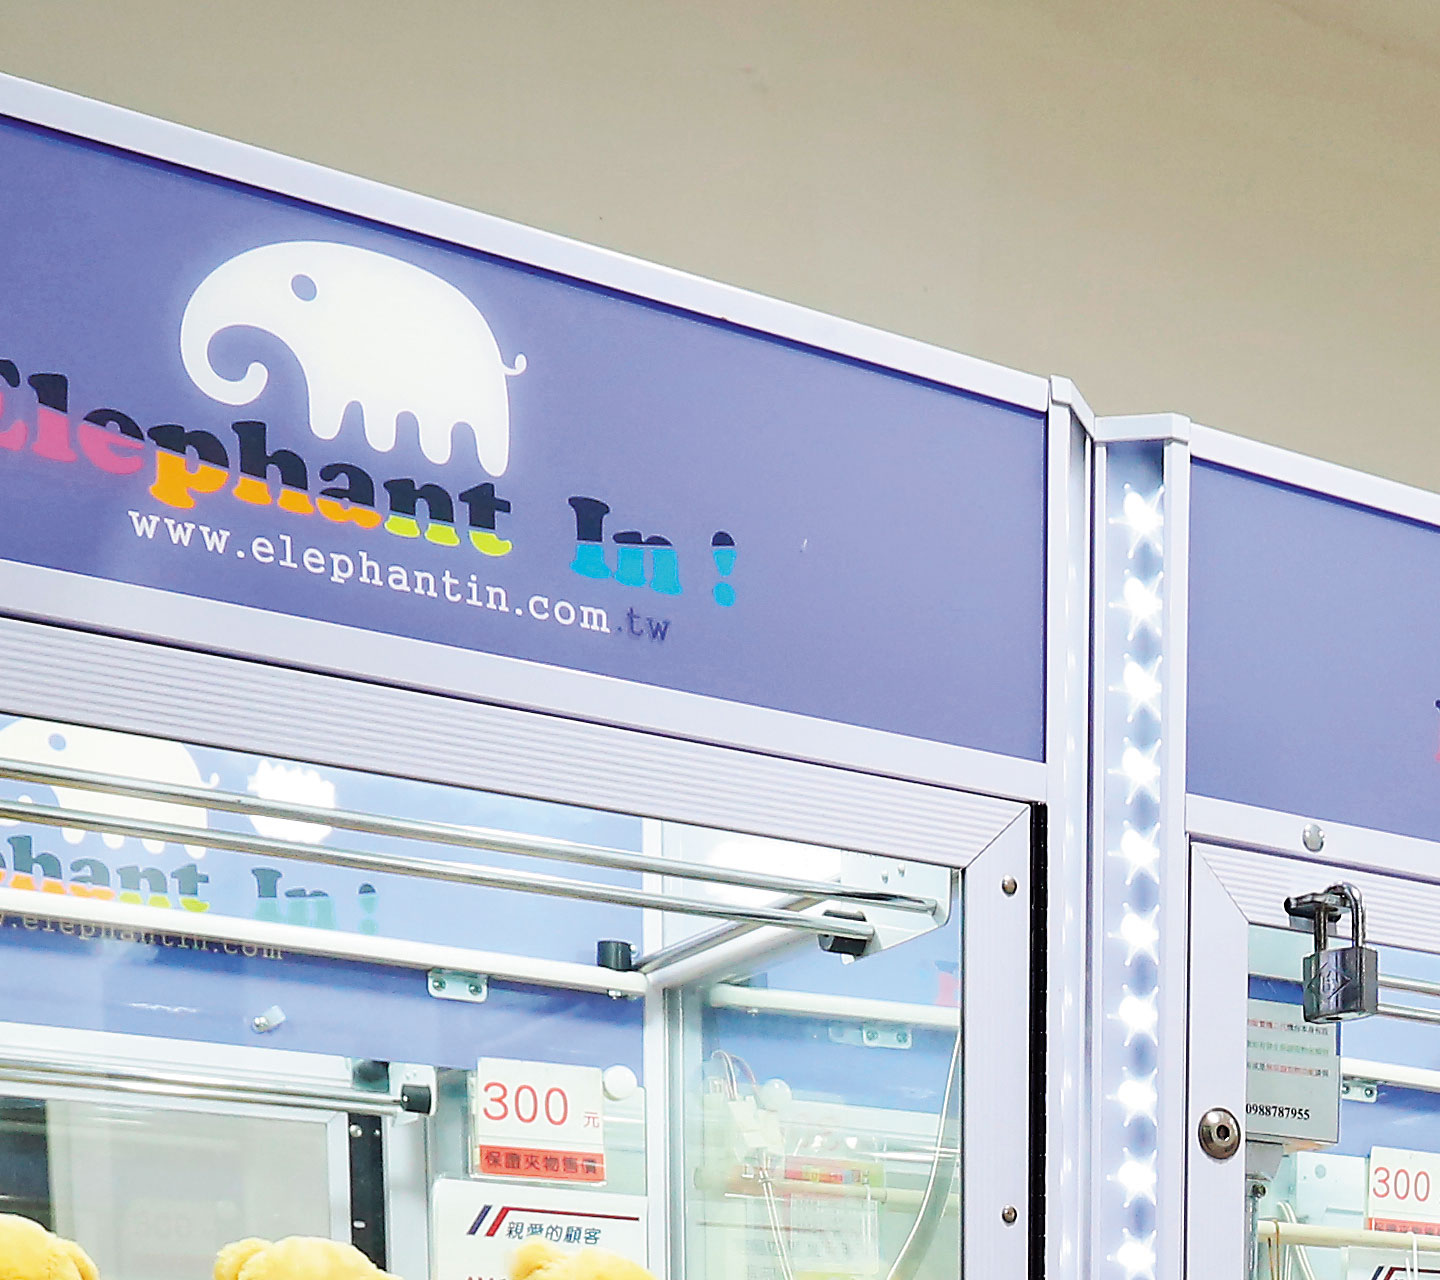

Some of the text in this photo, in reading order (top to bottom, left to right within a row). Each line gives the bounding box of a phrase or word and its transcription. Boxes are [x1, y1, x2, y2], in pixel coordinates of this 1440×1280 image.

[128, 504, 671, 643] www.elephantin.com.tw
[483, 1082, 600, 1128] 300 元
[1373, 1167, 1430, 1202] 300
